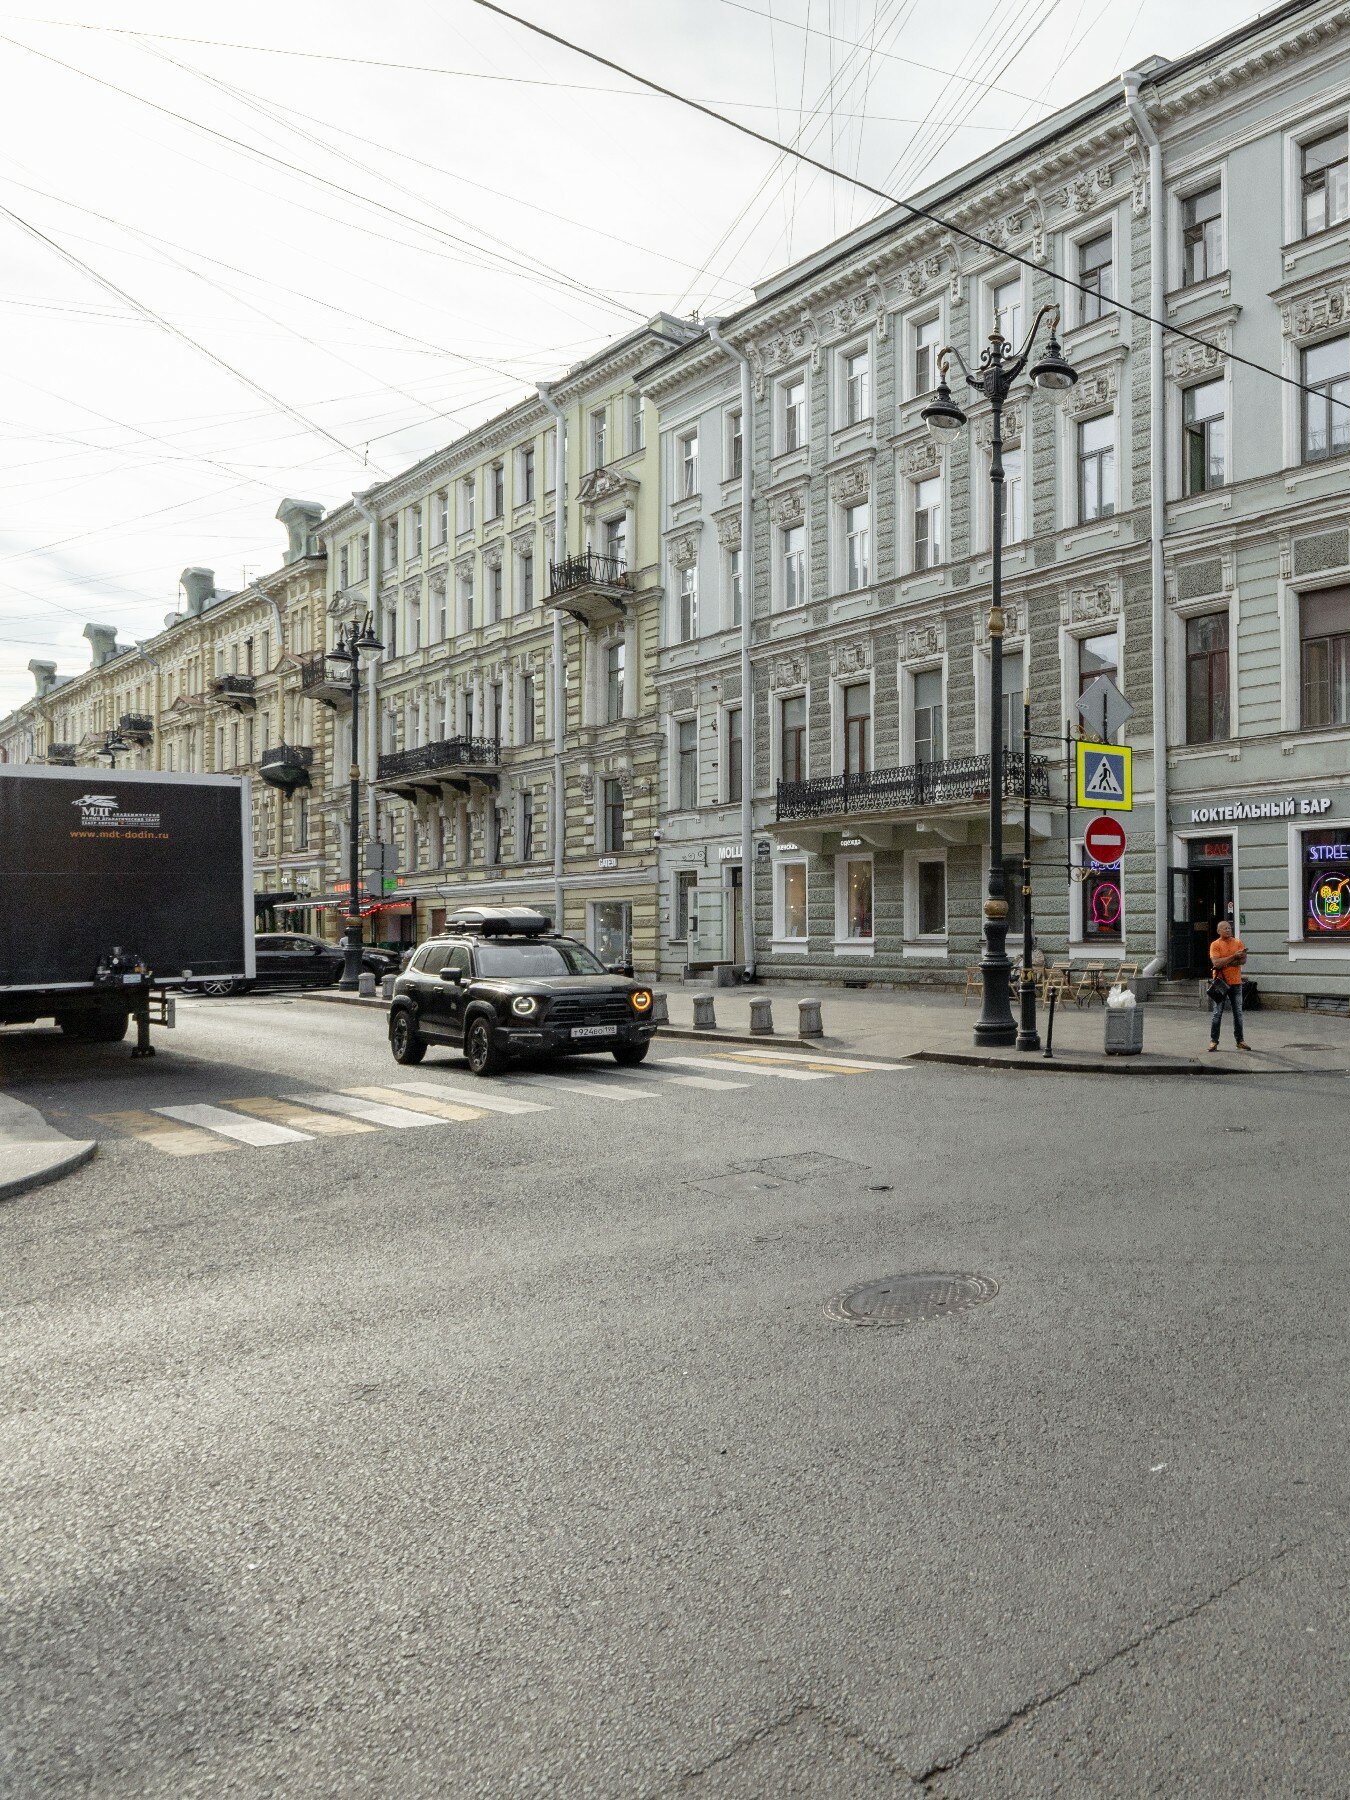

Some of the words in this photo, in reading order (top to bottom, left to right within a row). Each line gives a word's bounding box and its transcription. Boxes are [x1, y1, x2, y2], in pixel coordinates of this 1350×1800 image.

[1191, 797, 1296, 823] КОКТЕЙЛЬНЫЙ
[1300, 797, 1332, 815] БАР
[69, 830, 169, 839] www.mdt-dodin.ru
[1204, 843, 1230, 858] BAR
